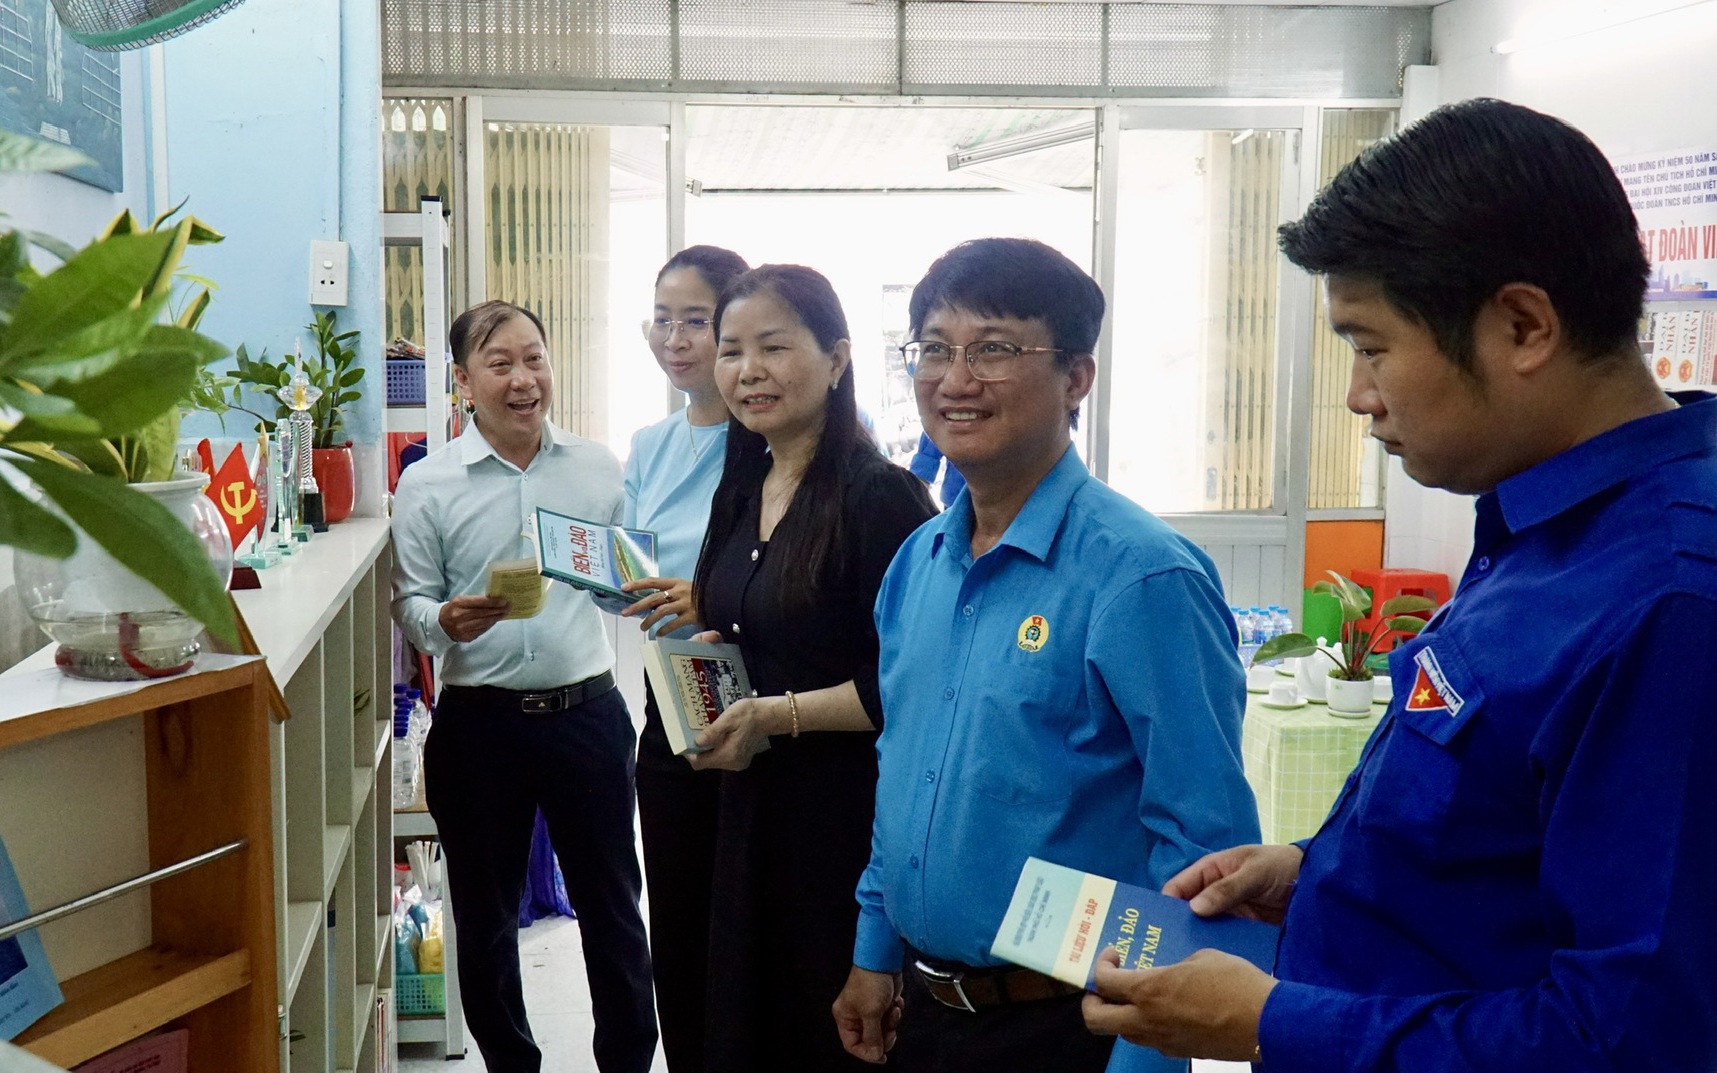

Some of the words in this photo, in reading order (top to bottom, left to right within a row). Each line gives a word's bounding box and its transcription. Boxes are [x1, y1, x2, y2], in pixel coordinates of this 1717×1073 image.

[1703, 178, 1716, 192] VIỆT
[1658, 219, 1699, 262] ĐOÀN
[1702, 224, 1717, 260] VI
[588, 529, 598, 553] NAM
[697, 671, 716, 712] 1945
[1118, 907, 1140, 935] ĐẢO
[1142, 924, 1162, 955] NAM
